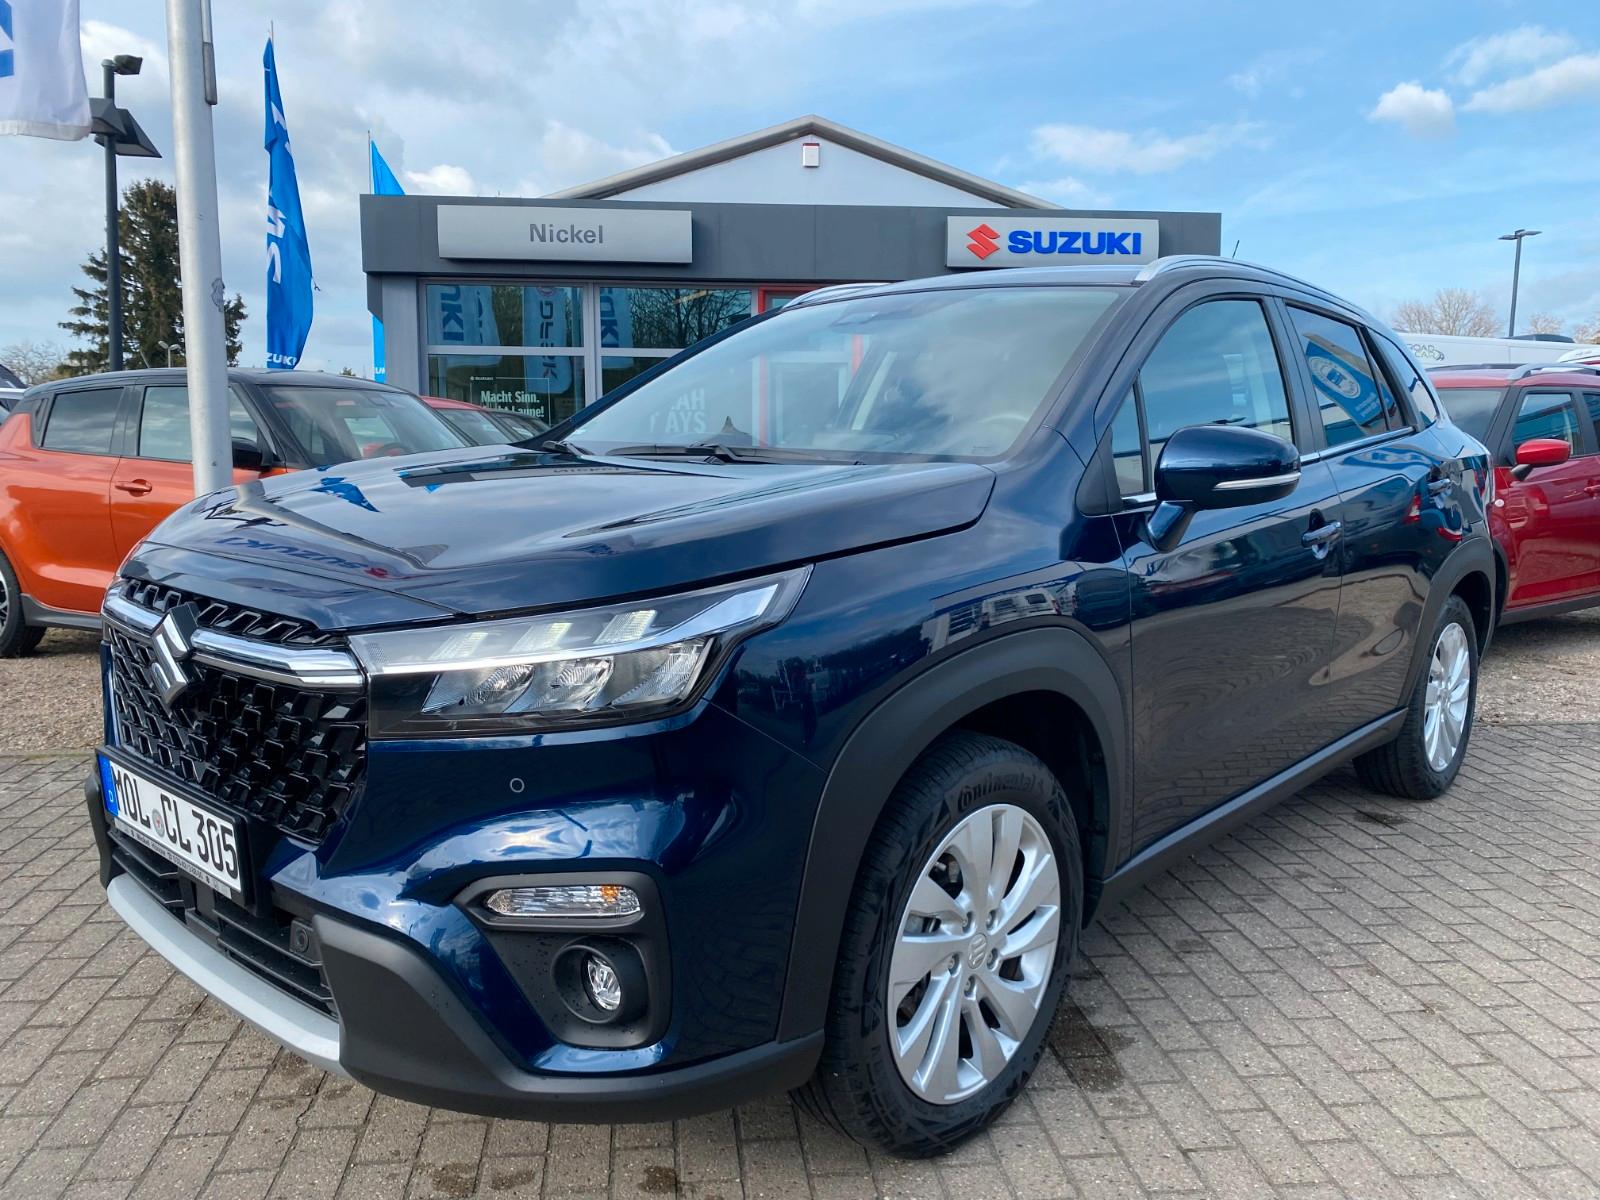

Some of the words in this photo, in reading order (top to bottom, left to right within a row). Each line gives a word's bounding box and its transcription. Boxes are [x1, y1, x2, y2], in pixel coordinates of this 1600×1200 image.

[529, 223, 603, 244] Nickel
[1007, 230, 1142, 255] SUZUKI
[481, 390, 512, 403] Macht
[515, 390, 540, 403] Sinn.
[671, 387, 705, 410] AH
[111, 765, 151, 830] MOL
[160, 792, 192, 854] CL
[191, 808, 240, 880] 305
